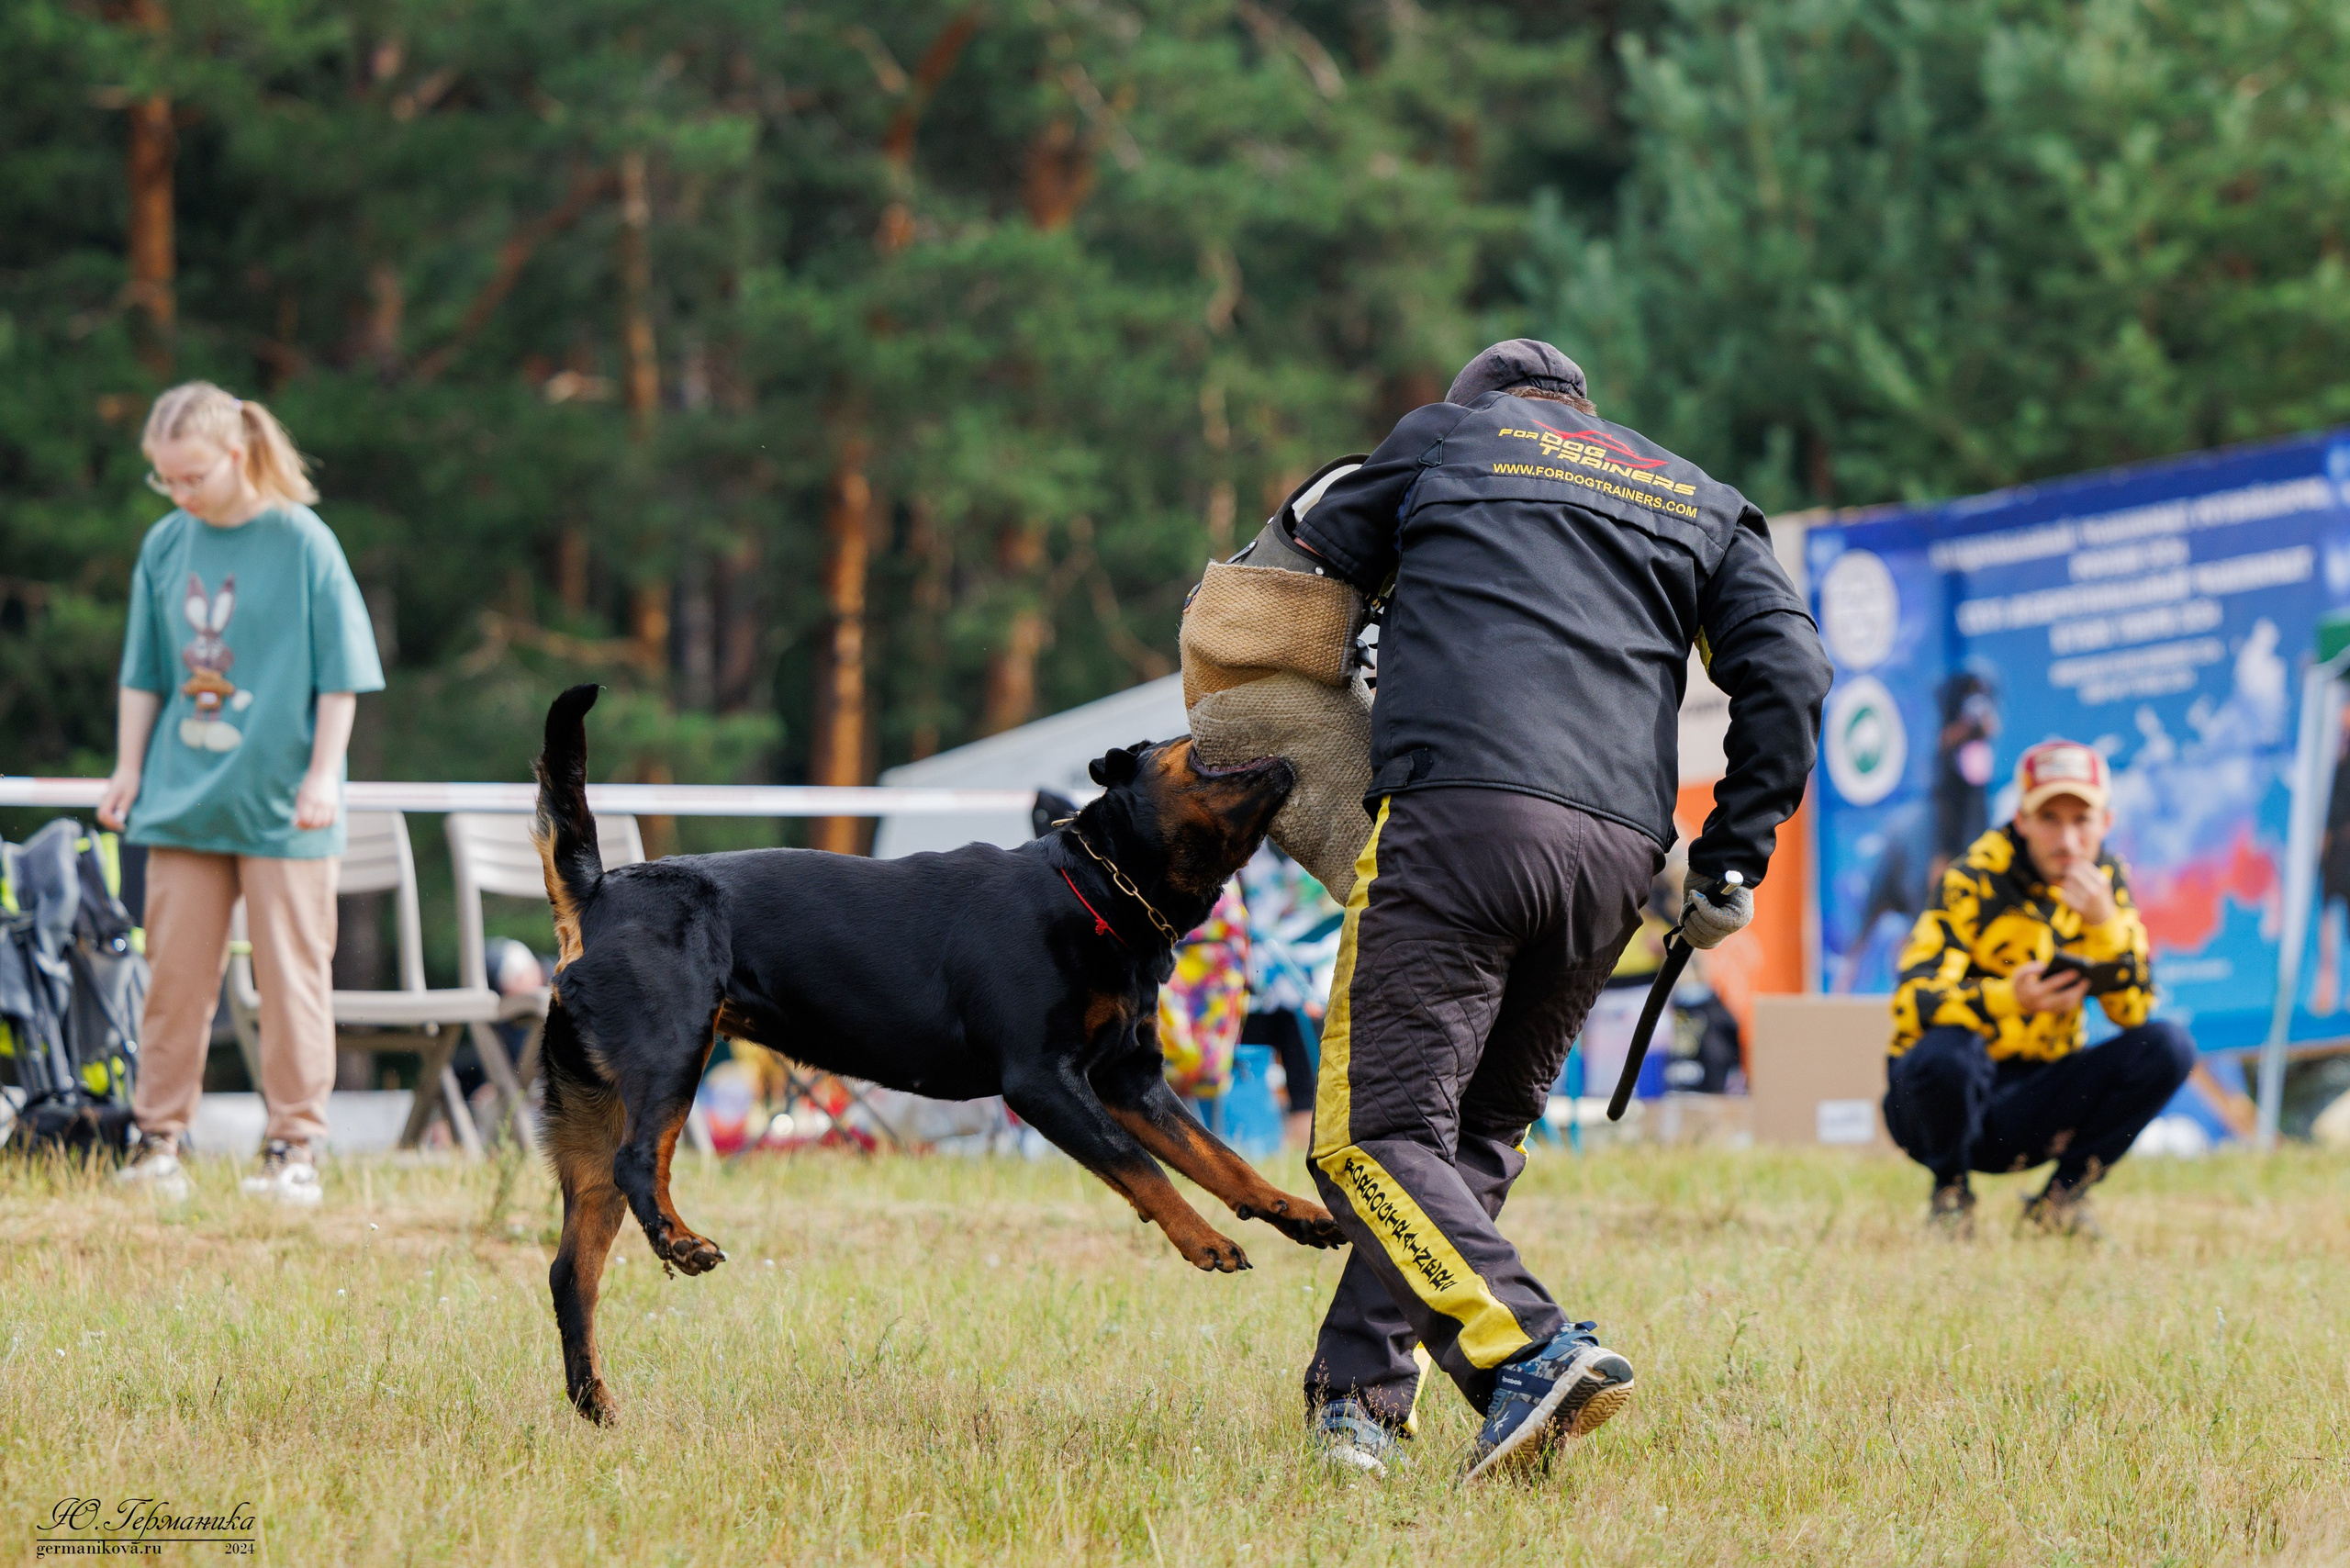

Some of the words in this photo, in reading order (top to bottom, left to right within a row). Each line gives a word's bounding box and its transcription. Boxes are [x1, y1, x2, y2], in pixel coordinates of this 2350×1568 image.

[1498, 428, 1539, 441] FOR
[1539, 431, 1606, 459] DOG
[1539, 442, 1696, 497] TRAINERS
[1493, 463, 1697, 519] WWW.FORDOGTRAINERS.COM
